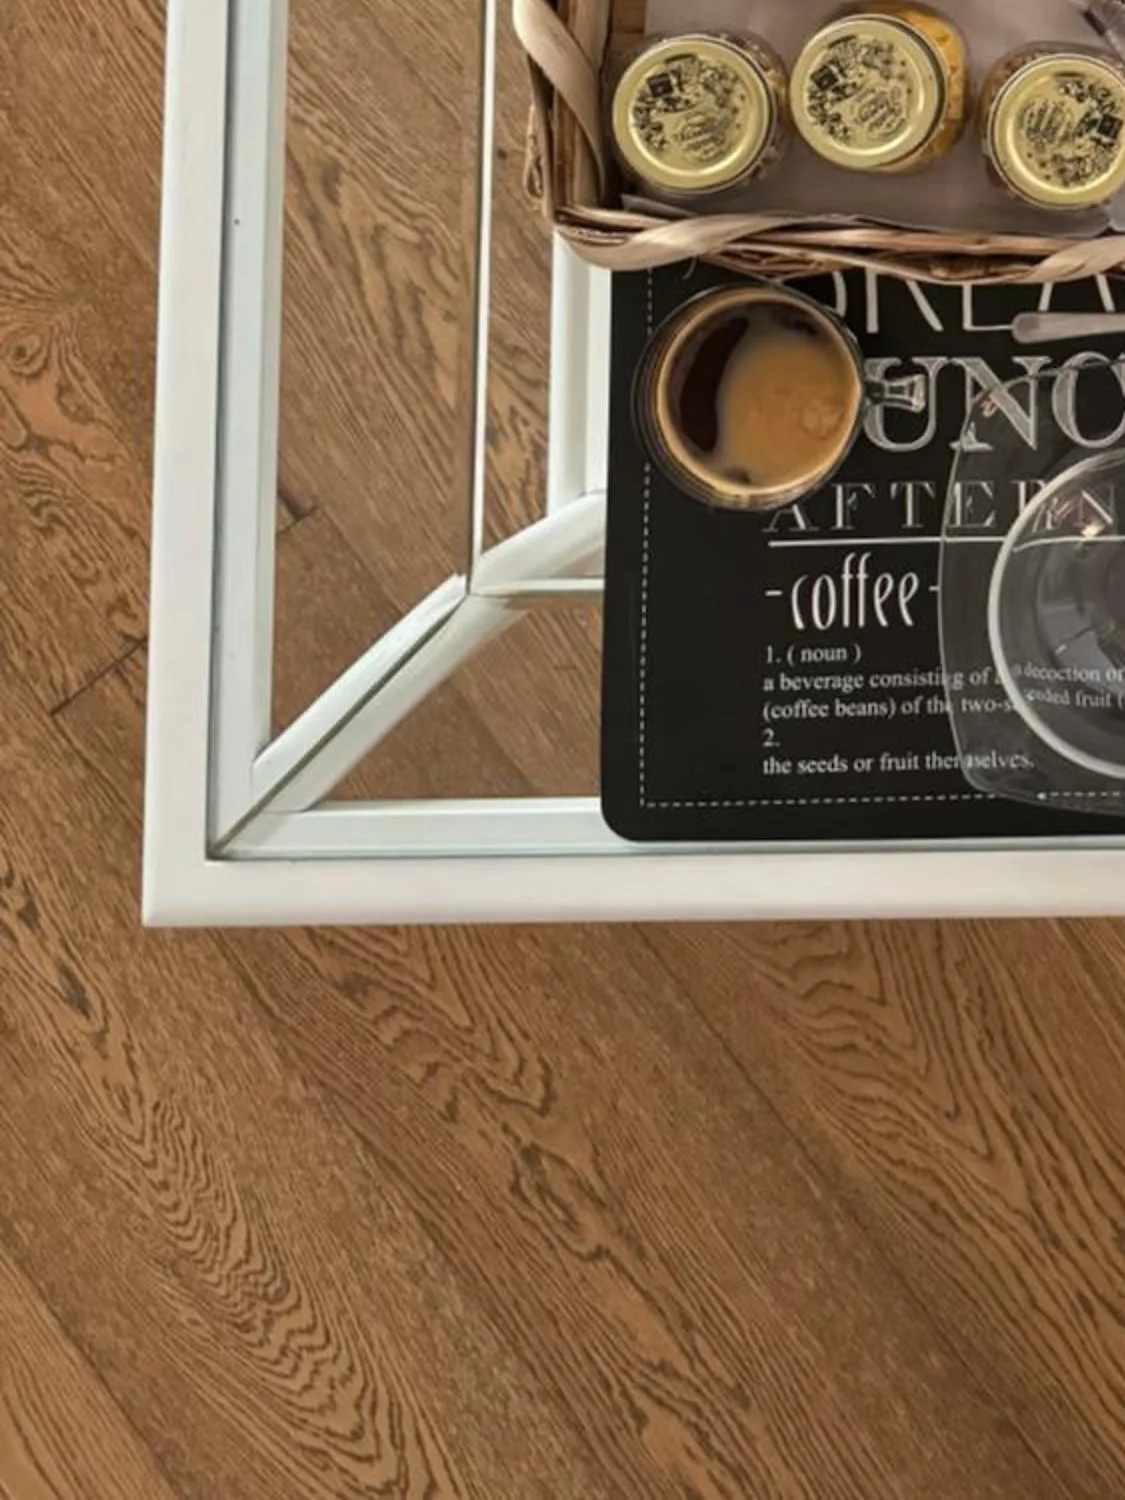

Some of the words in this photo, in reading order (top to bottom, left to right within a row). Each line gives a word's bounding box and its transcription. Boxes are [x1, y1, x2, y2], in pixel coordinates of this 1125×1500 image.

[763, 680, 774, 692] a
[780, 672, 865, 693] beverage
[869, 668, 965, 691] consistig
[968, 666, 992, 685] of
[1105, 666, 1125, 682] or
[763, 699, 829, 722] (coffee
[835, 698, 896, 719] beans)
[901, 696, 921, 714] of
[1075, 689, 1112, 709] fruit
[763, 728, 780, 747] 2.
[763, 756, 792, 775] the
[797, 753, 849, 774] seeds
[853, 757, 873, 772] or
[879, 752, 920, 771] fruit
